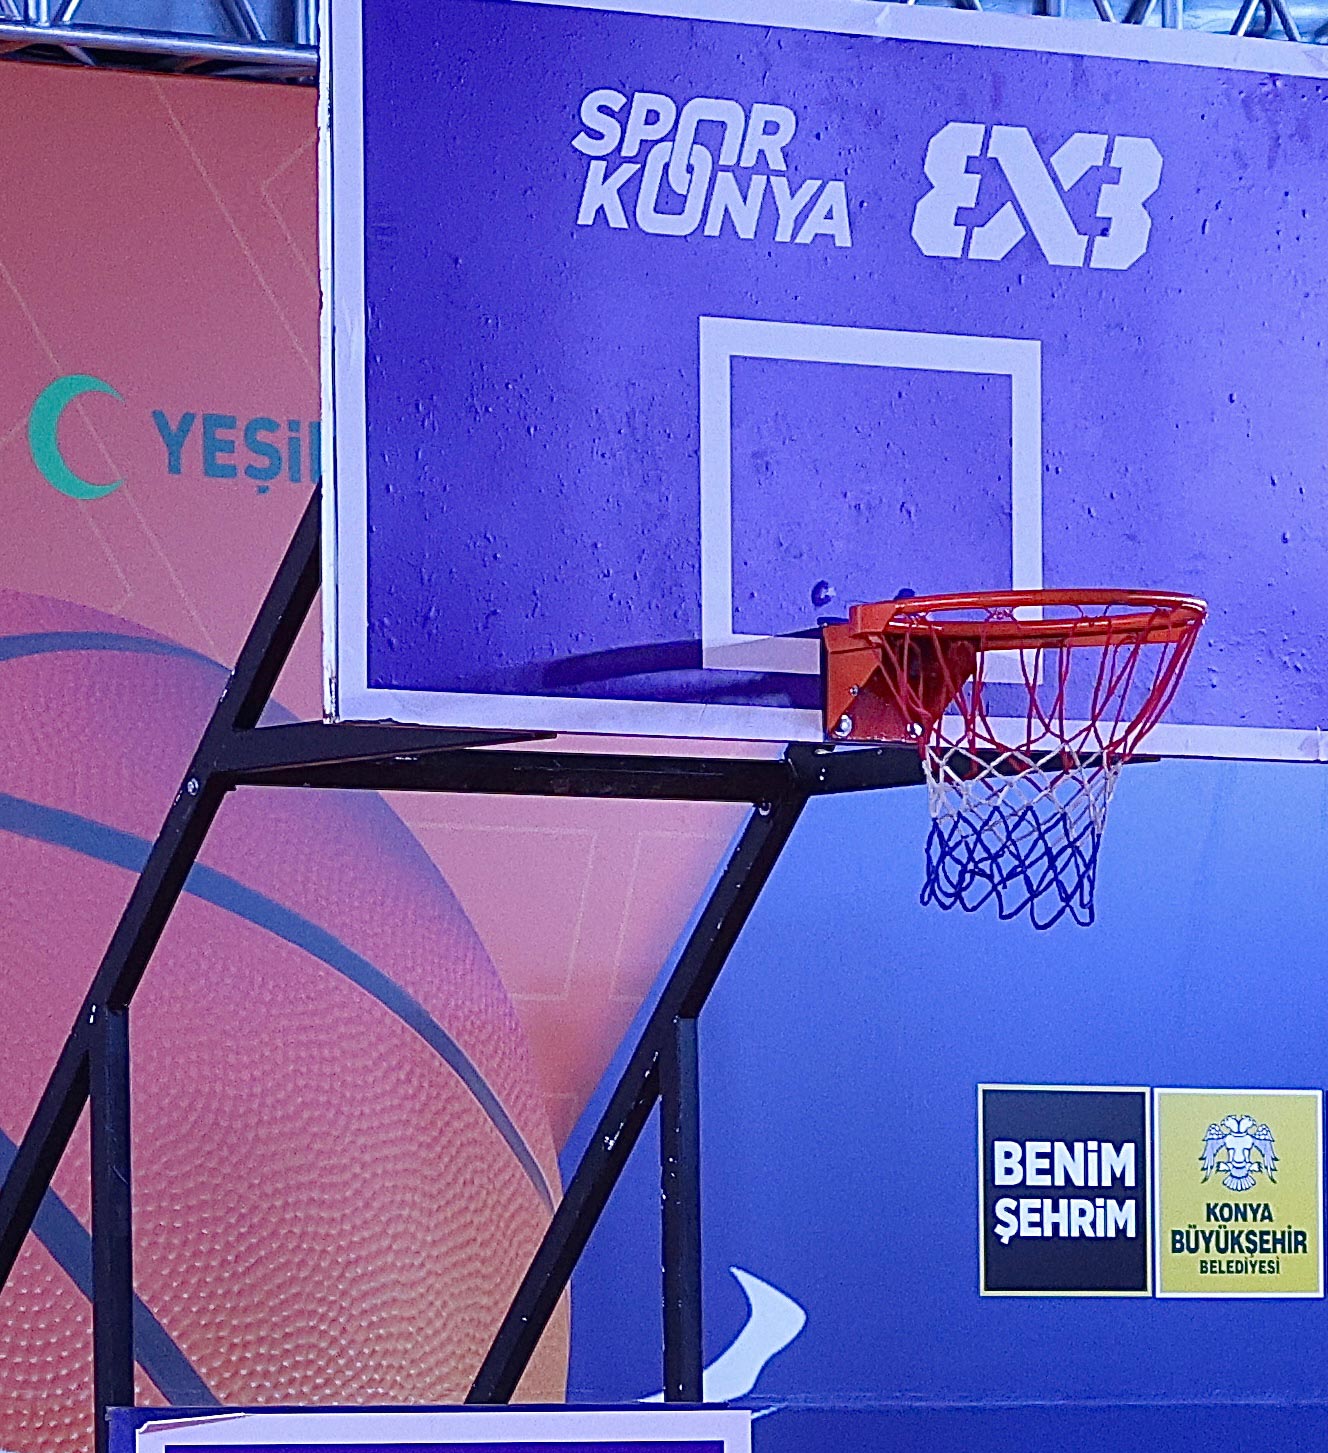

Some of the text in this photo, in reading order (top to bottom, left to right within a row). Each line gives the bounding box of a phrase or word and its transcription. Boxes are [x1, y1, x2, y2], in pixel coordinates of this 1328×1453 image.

[570, 89, 796, 194] SPOR
[576, 141, 852, 247] KONYA
[1205, 1202, 1274, 1222] KONYA
[1170, 1224, 1307, 1257] BÜYÜKŞEHİR
[1199, 1256, 1280, 1275] BELEDİYESİ
